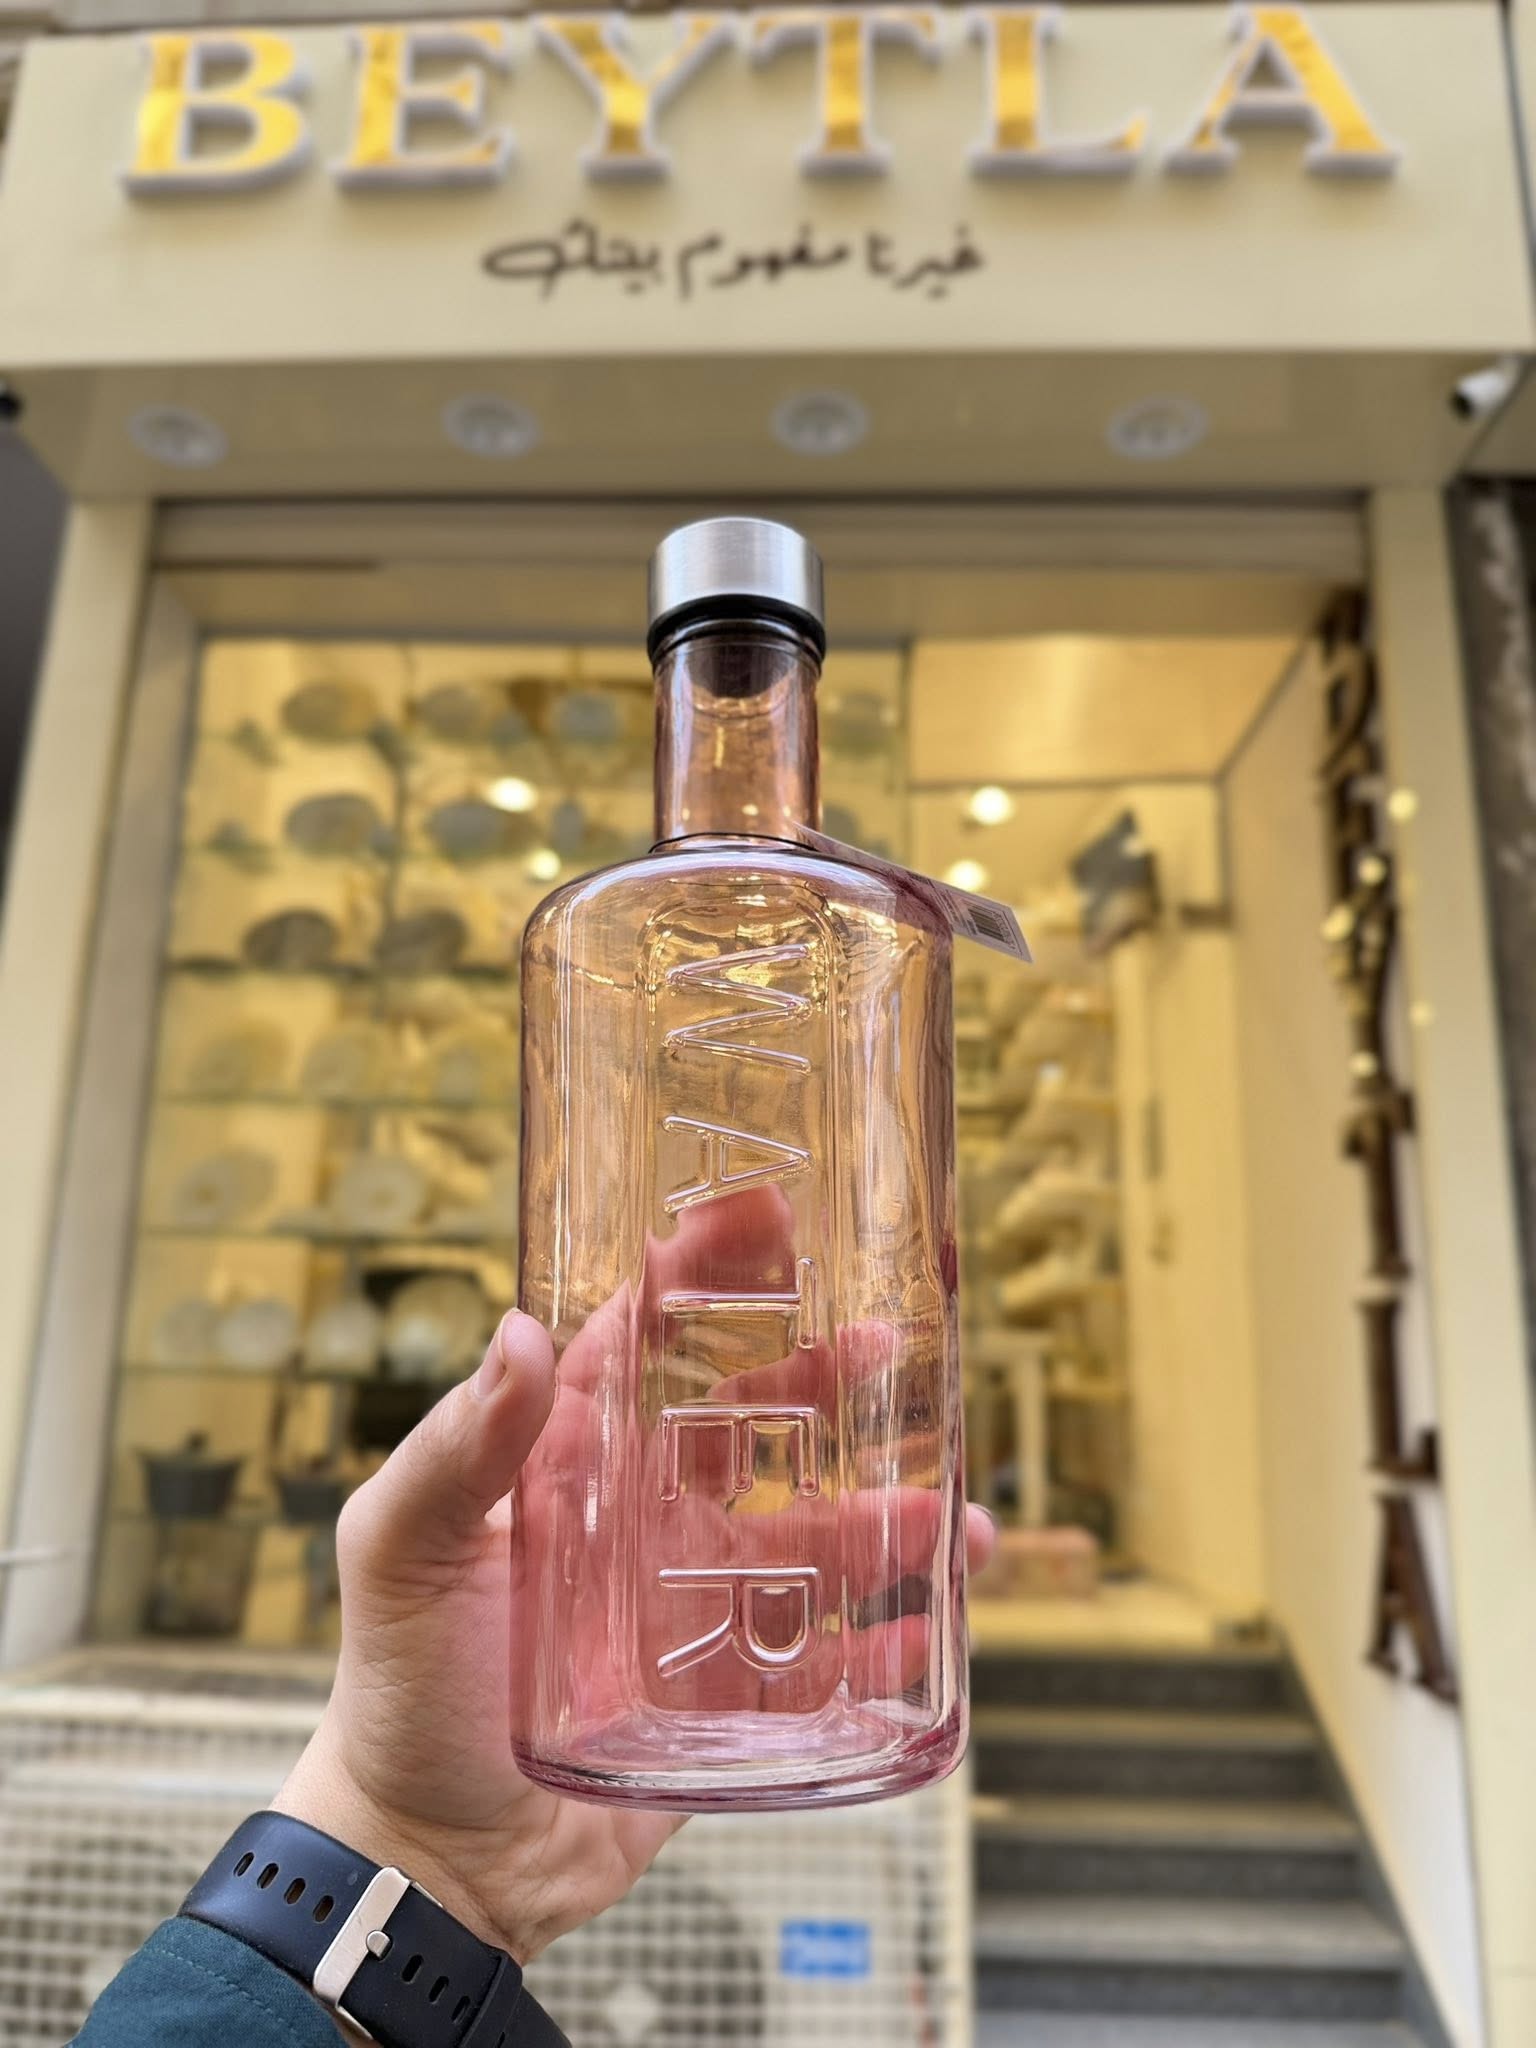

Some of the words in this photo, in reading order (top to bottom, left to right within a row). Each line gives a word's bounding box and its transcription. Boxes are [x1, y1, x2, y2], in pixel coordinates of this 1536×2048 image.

[120, 5, 1402, 198] BEYTLA
[679, 222, 850, 301] مفهوم
[657, 942, 823, 1678] WATER
